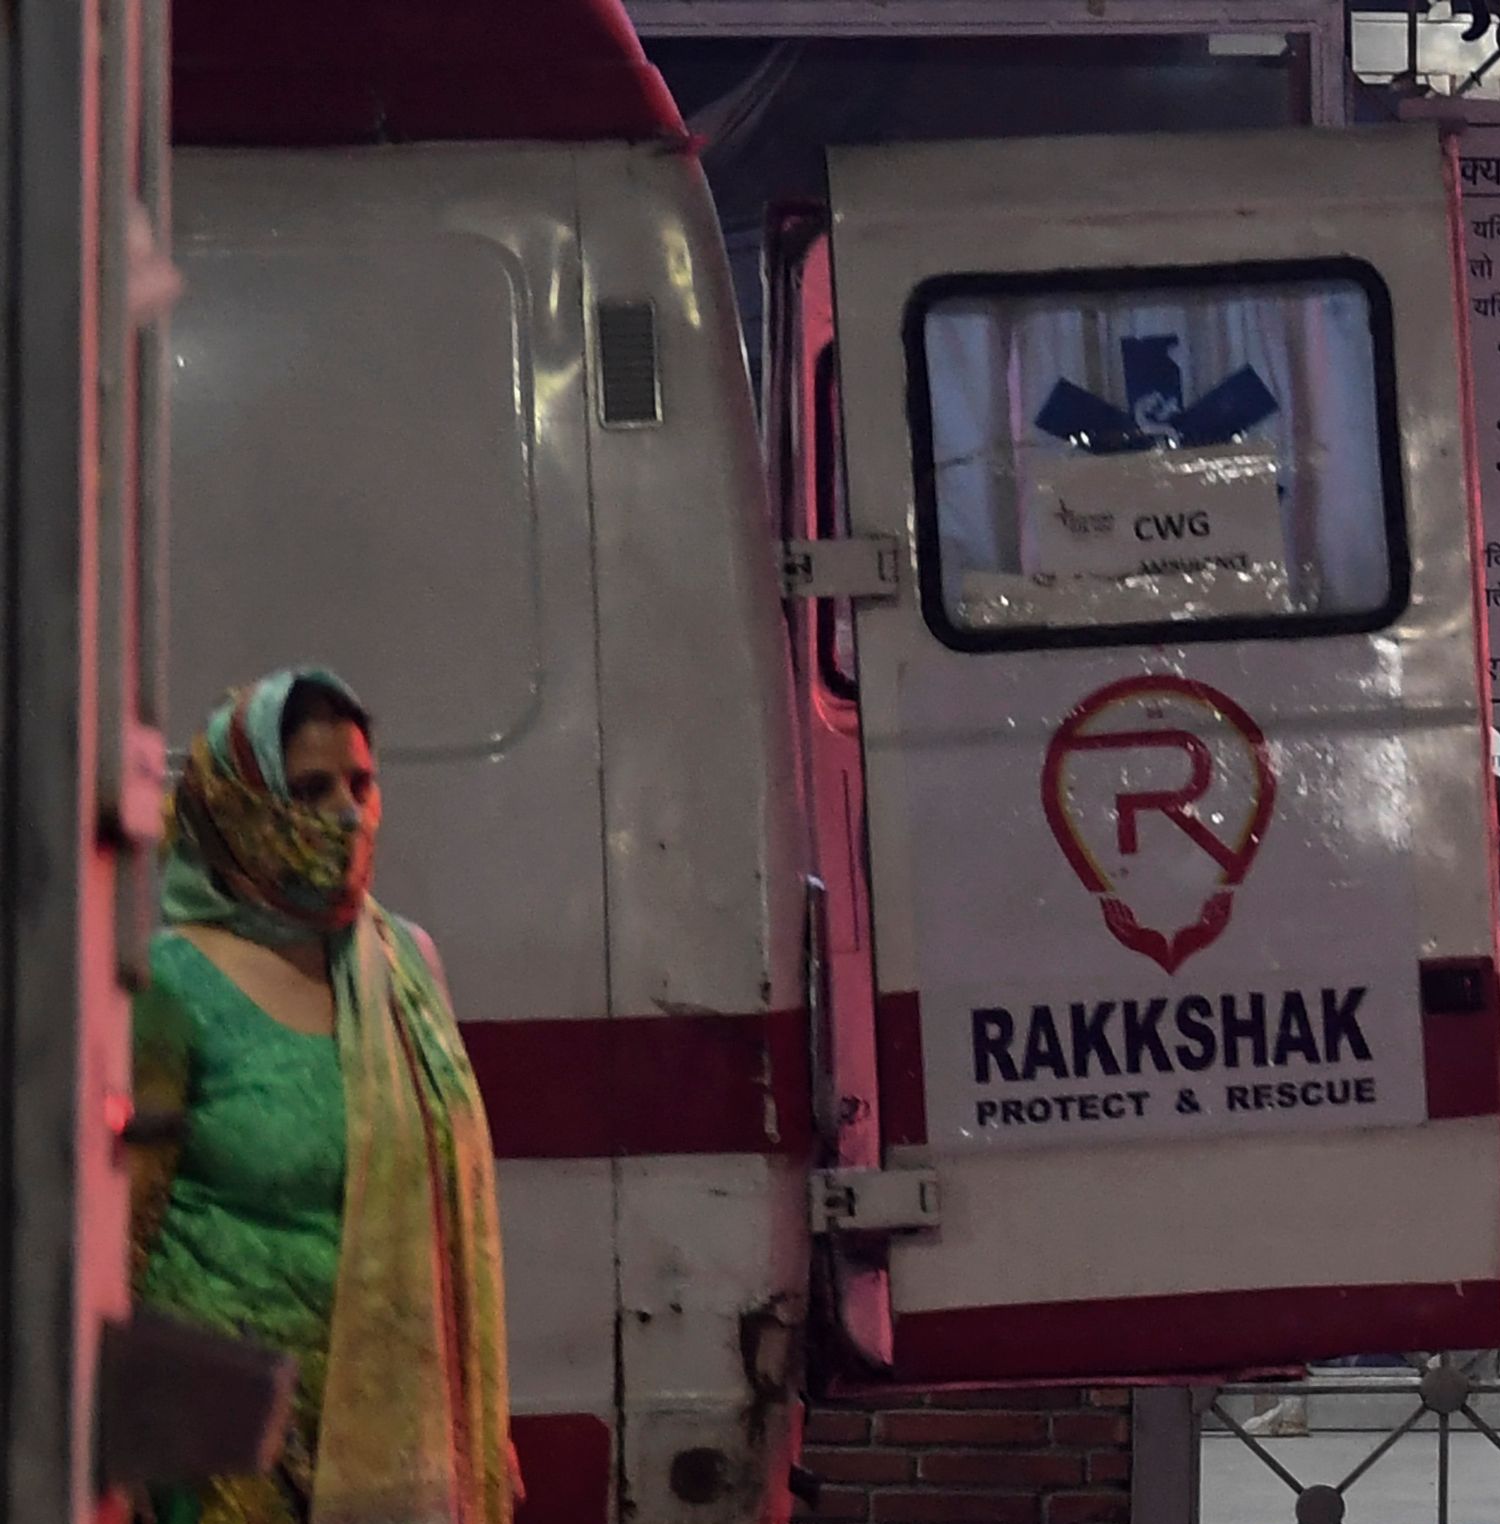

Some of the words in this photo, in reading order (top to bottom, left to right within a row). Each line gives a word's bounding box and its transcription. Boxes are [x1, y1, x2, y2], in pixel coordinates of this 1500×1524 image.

[1133, 511, 1211, 542] CWG
[971, 986, 1374, 1084] RAKKSHAK
[976, 1089, 1150, 1127] PROTECT
[1174, 1088, 1202, 1114] &
[1226, 1077, 1378, 1112] RESCUE
